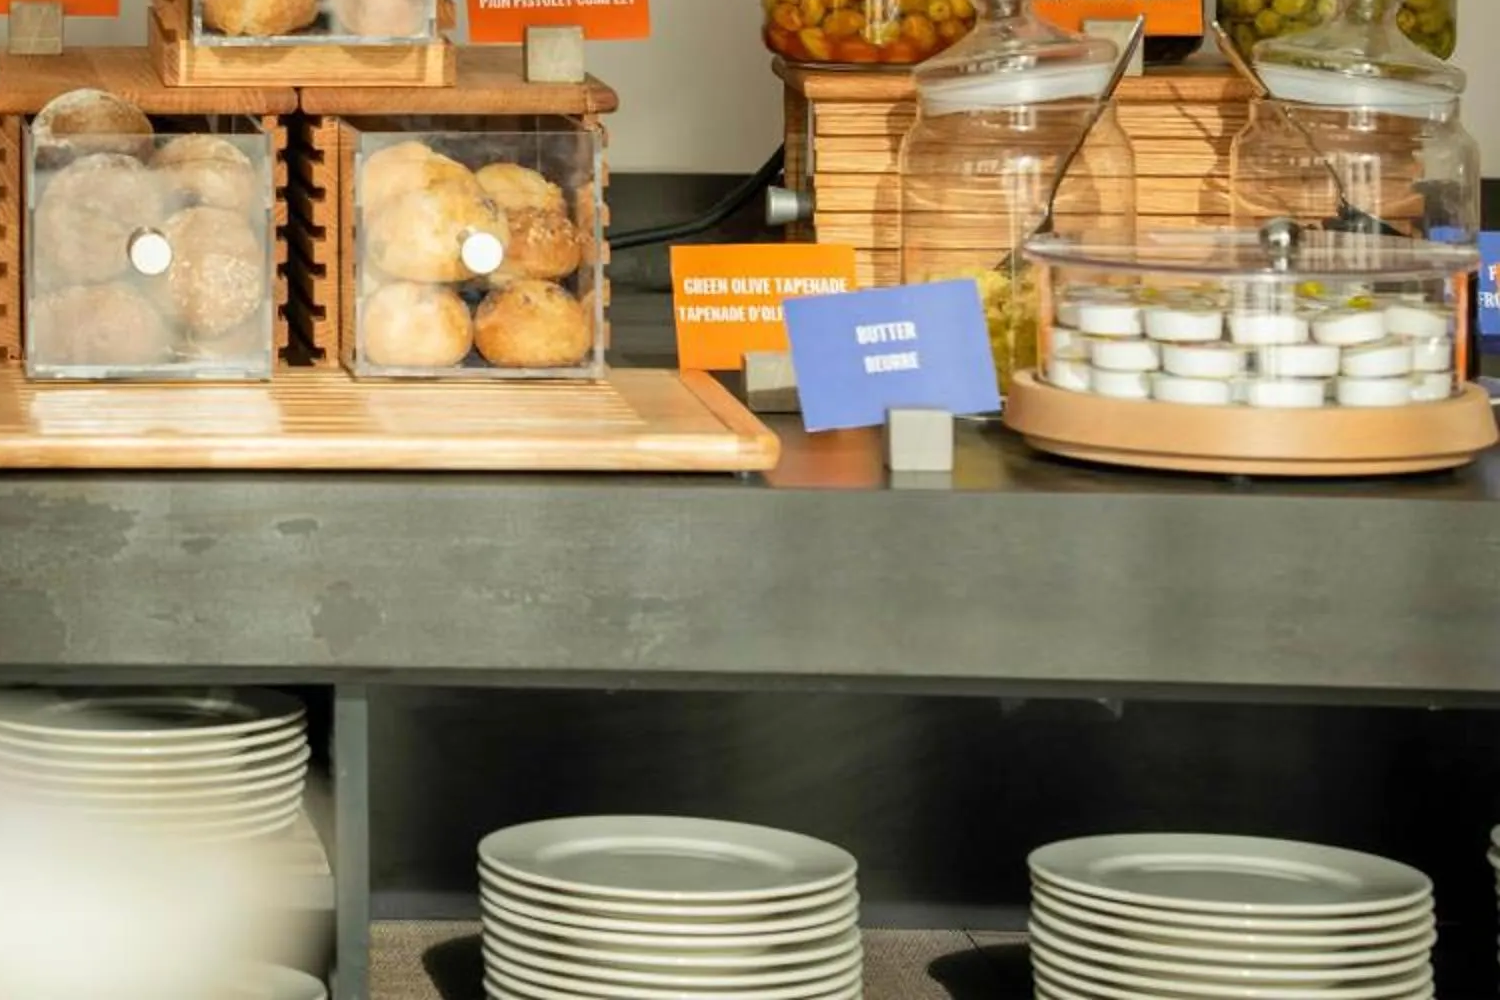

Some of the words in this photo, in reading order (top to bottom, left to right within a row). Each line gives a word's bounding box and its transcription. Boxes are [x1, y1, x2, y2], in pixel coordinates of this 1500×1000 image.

[683, 277, 728, 295] GREEN
[731, 277, 771, 295] OLIVE
[774, 277, 849, 295] TAPENADE
[679, 304, 746, 322] TAPENADE
[749, 305, 784, 322] D'OLI
[855, 321, 917, 344] BUTTER
[864, 351, 919, 374] BEURRE
